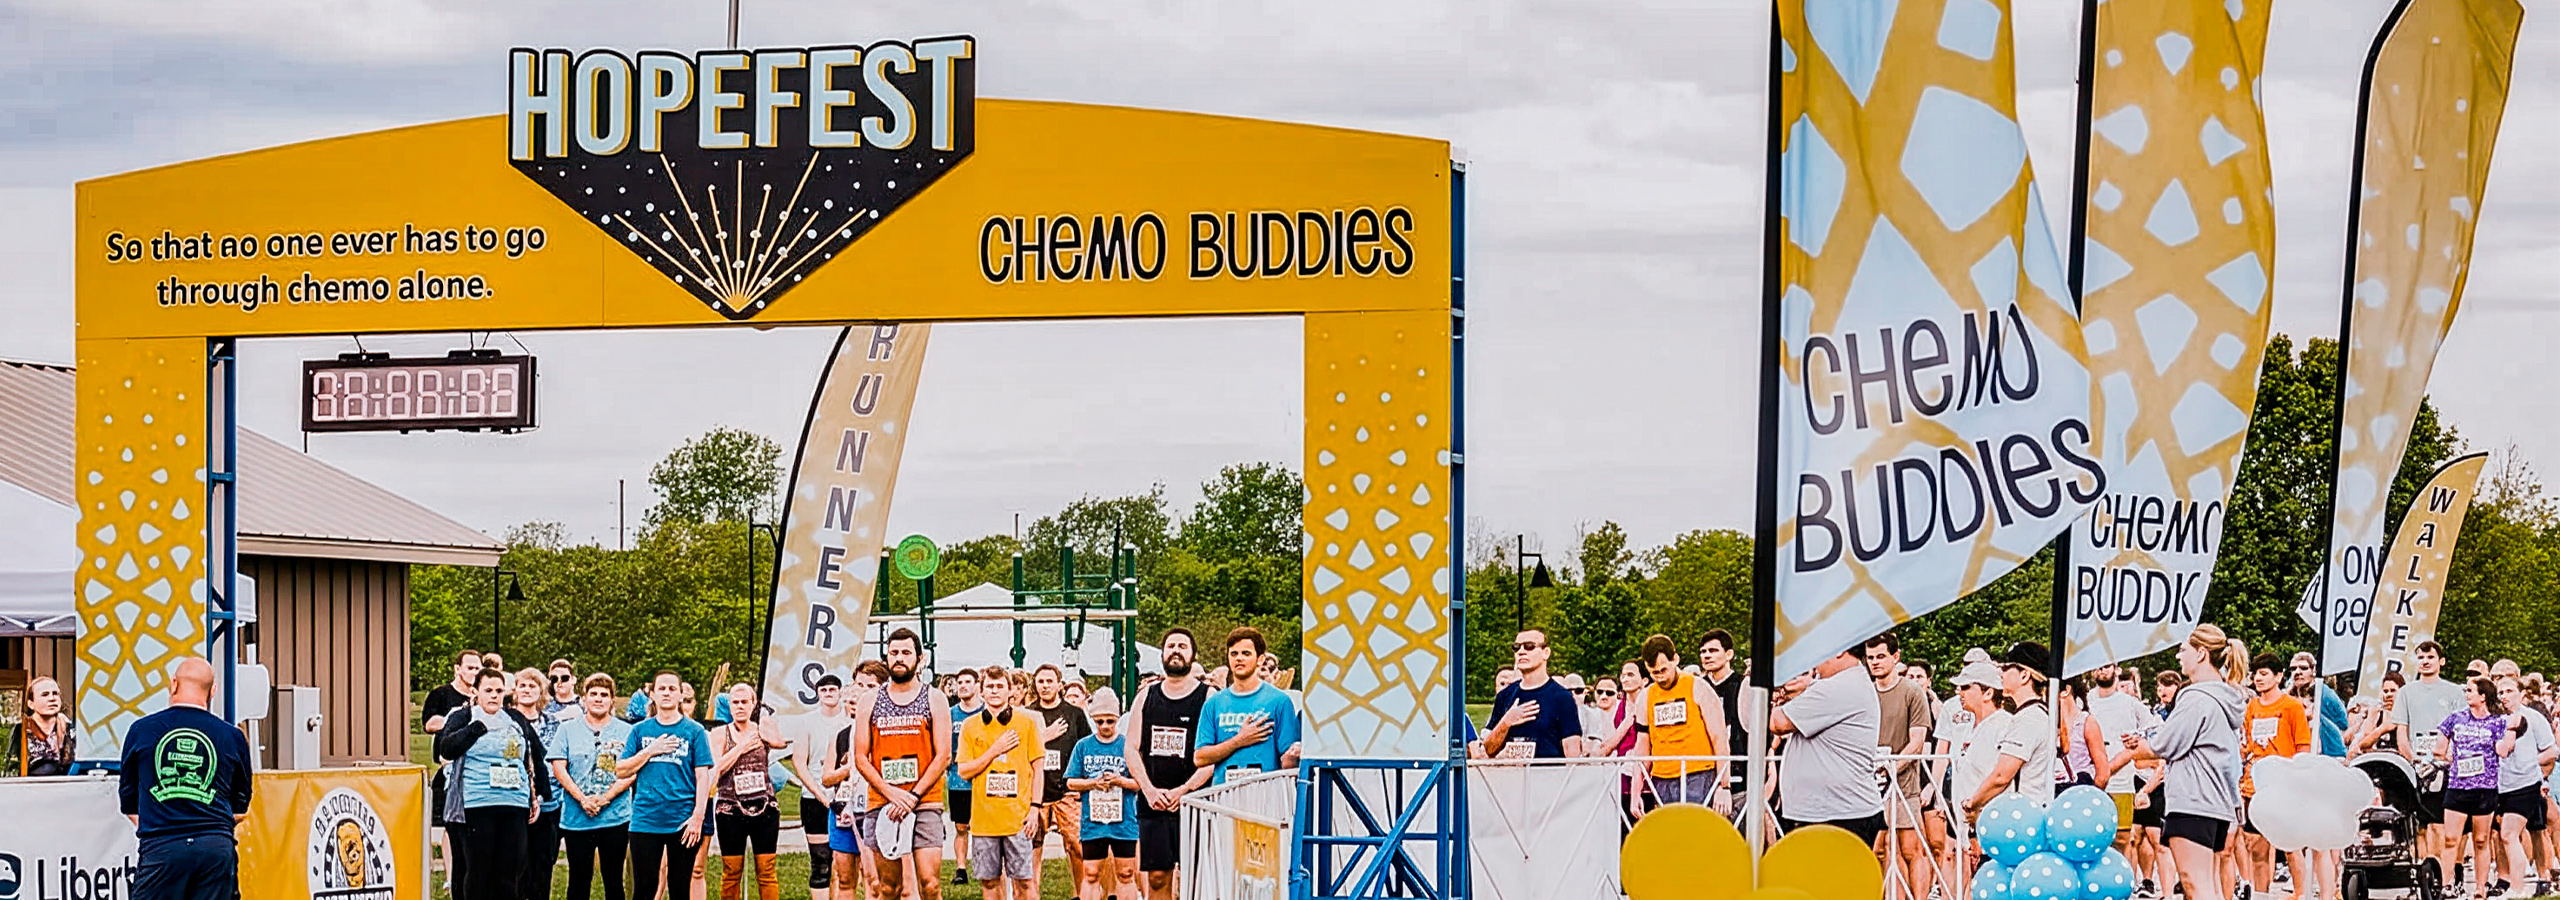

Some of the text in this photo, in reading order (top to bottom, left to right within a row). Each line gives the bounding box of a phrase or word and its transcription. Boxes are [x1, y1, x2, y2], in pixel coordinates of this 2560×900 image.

[511, 39, 972, 161] HOPEFEST
[106, 224, 545, 262] So that no one ever has to go
[156, 270, 493, 311] through chemo alone.
[797, 325, 899, 705] RUNNERS
